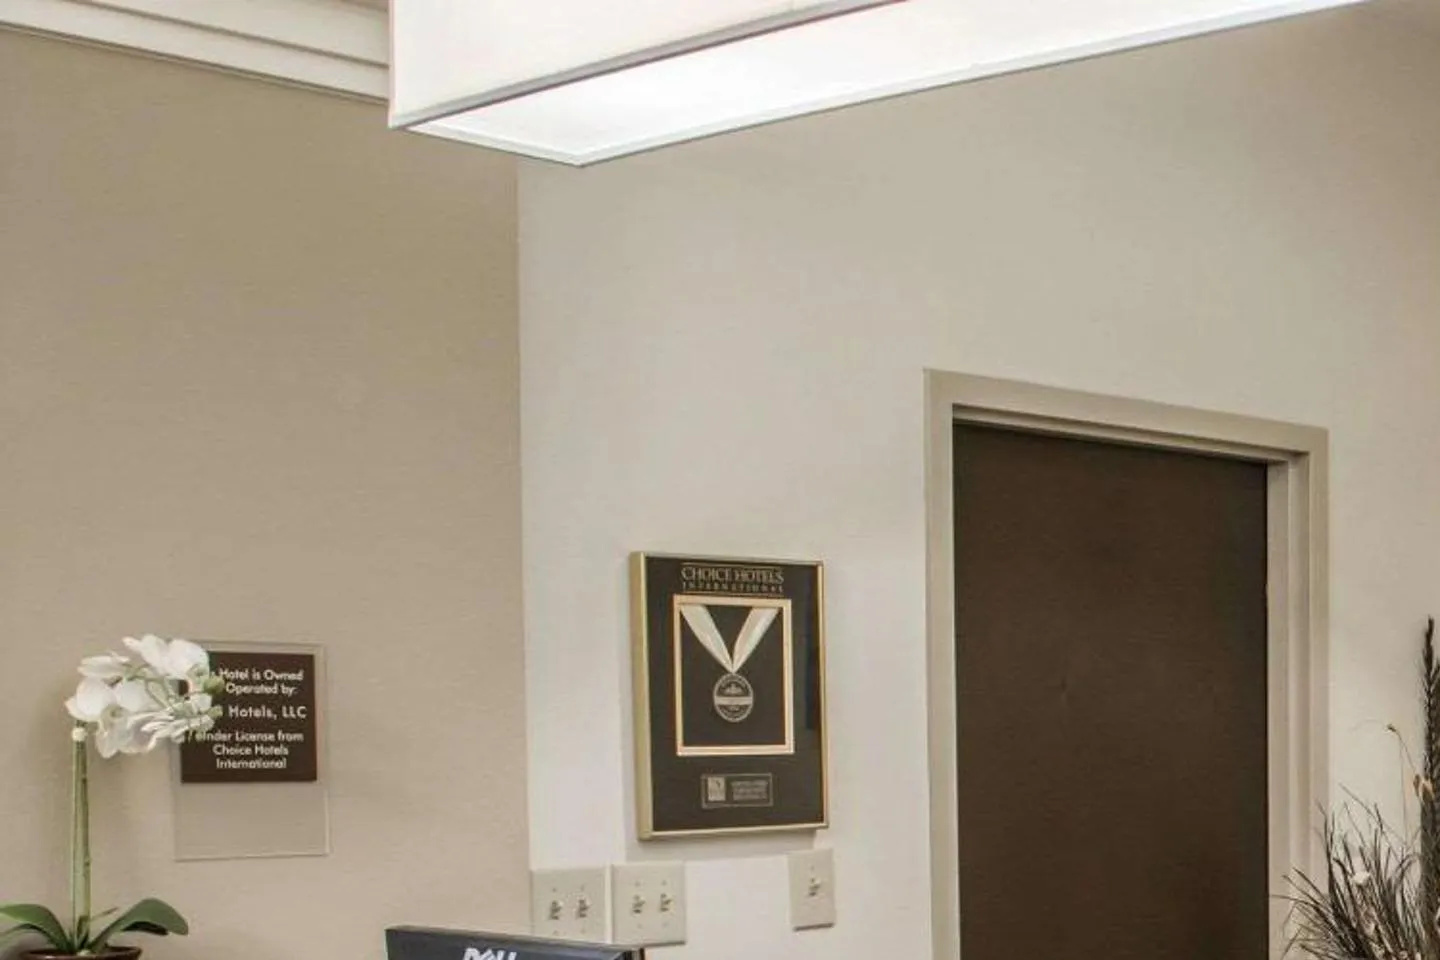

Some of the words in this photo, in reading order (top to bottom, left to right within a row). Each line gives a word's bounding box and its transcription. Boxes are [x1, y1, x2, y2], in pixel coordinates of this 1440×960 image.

[681, 566, 730, 581] CHOICE
[734, 569, 784, 584] HOTELS
[219, 668, 249, 681] Hotel
[252, 668, 261, 680] is
[263, 669, 304, 681] Owned
[225, 682, 278, 696] Operated
[228, 705, 277, 720] Hotels,
[282, 706, 307, 718] LLC
[235, 731, 275, 742] License
[277, 730, 304, 742] from
[212, 744, 252, 756] Choice
[254, 744, 289, 756] Hotels
[216, 758, 287, 769] International
